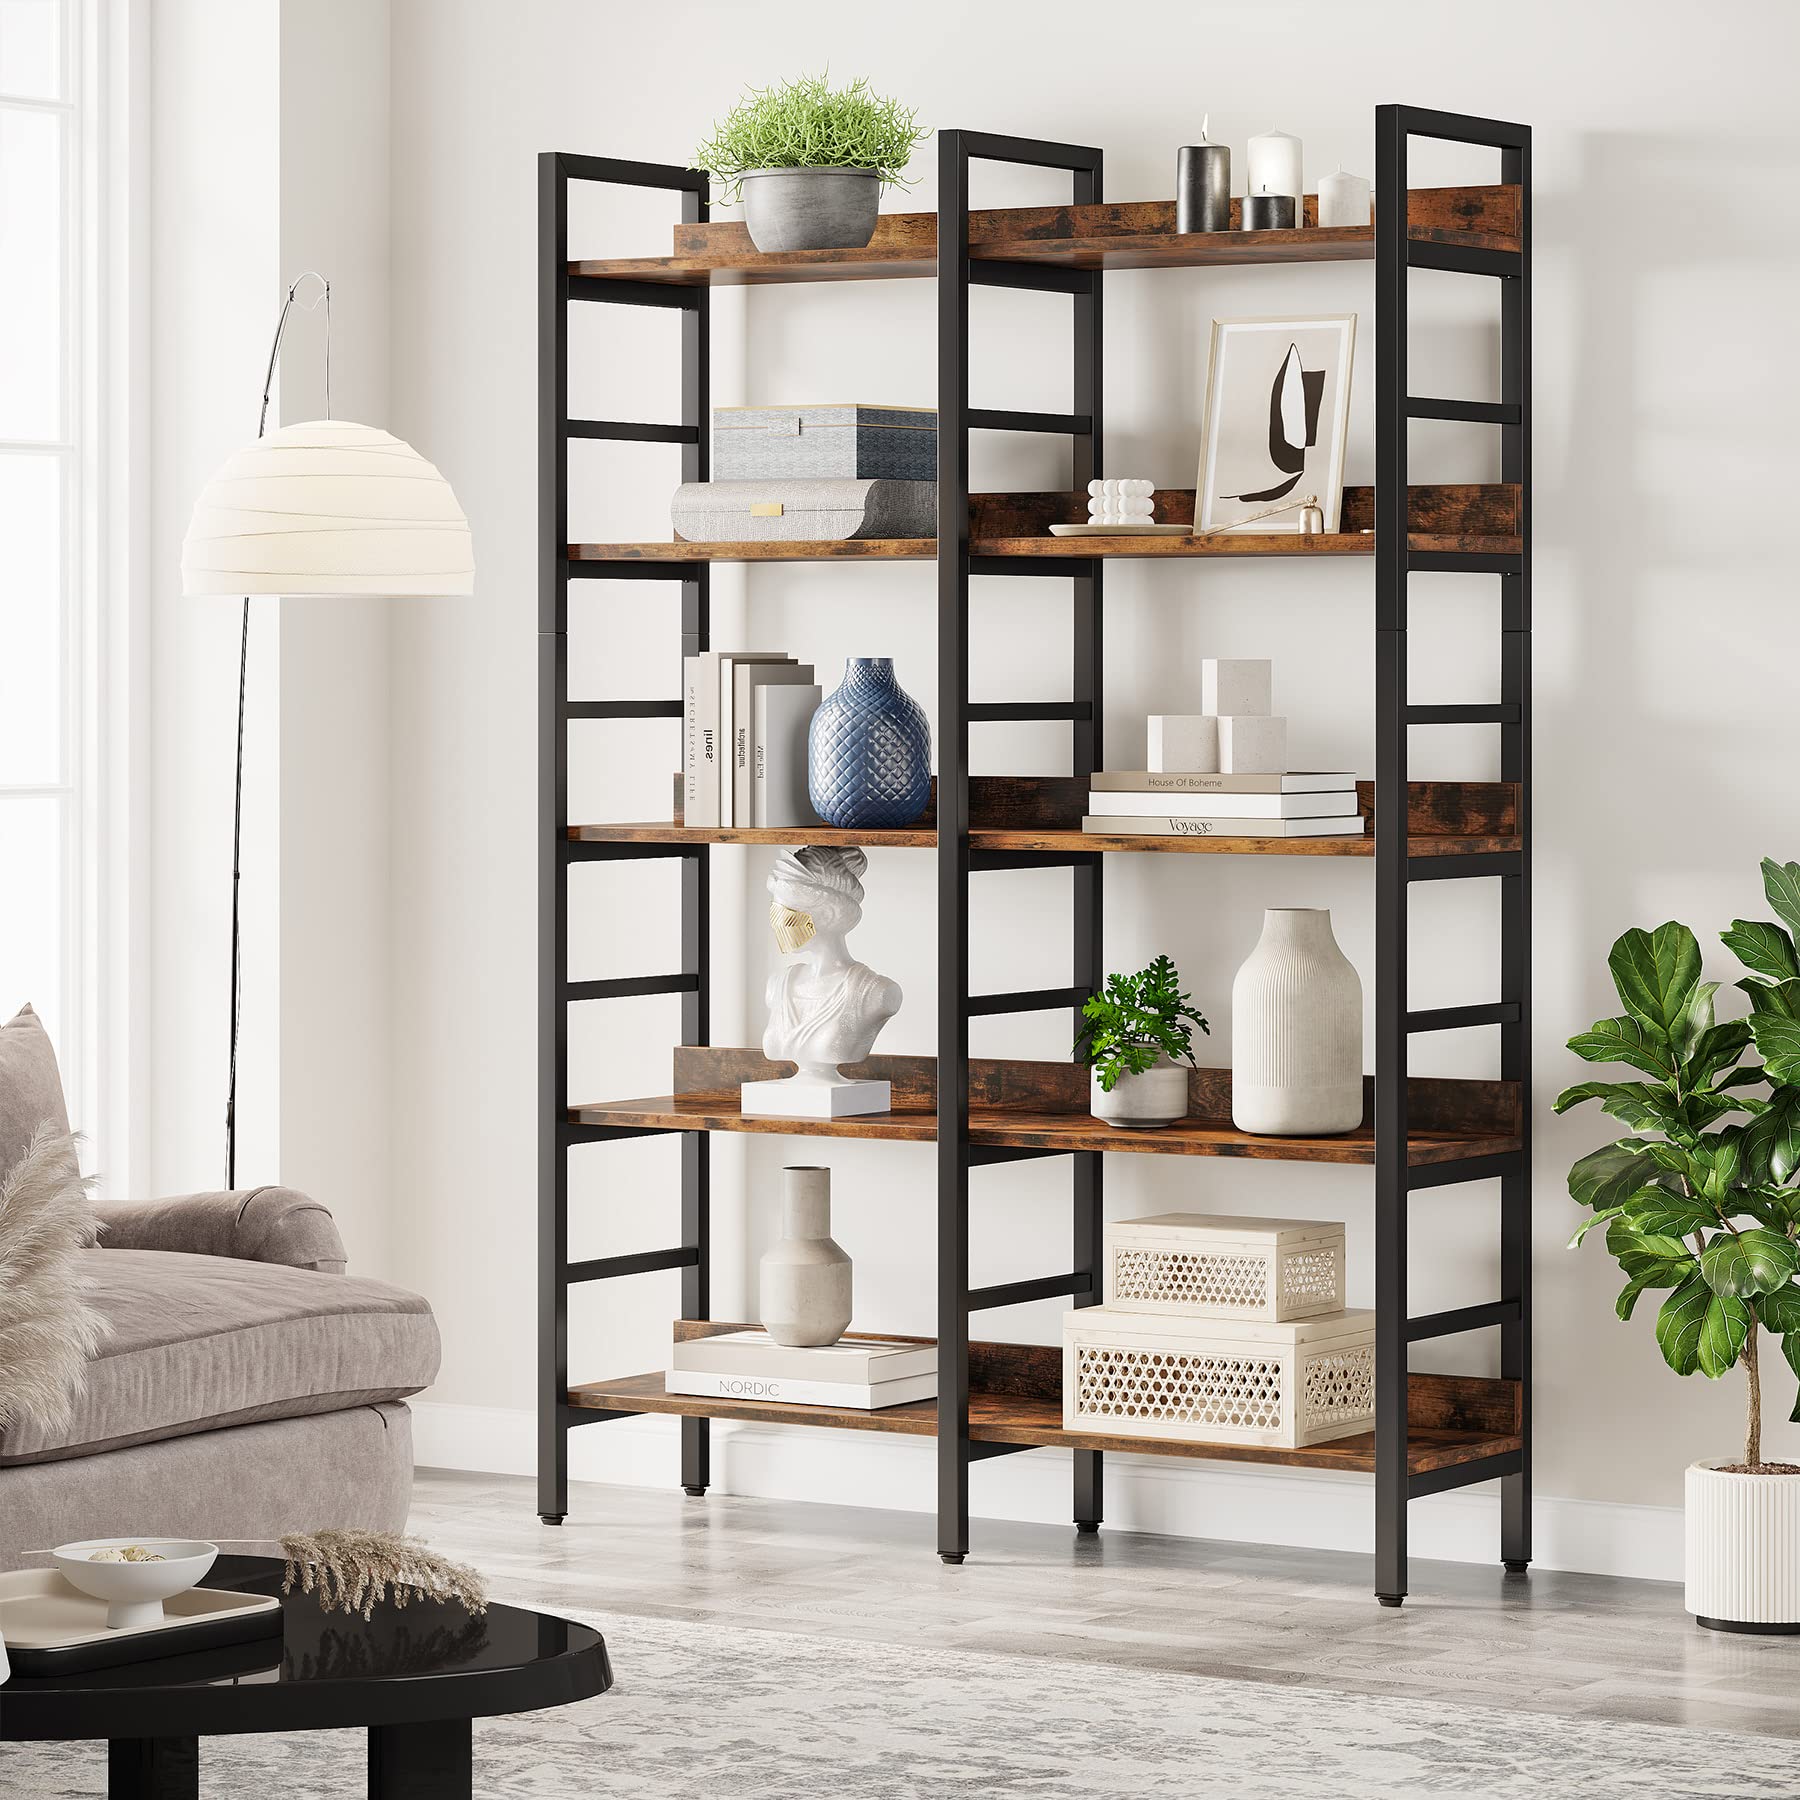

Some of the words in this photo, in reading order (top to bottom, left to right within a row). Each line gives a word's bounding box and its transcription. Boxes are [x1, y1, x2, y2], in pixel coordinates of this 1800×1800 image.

[1148, 778, 1174, 787] House
[1175, 778, 1187, 787] Of
[1188, 778, 1223, 788] Boheme
[1169, 818, 1213, 835] Voyage
[719, 1380, 780, 1397] NORDIC
